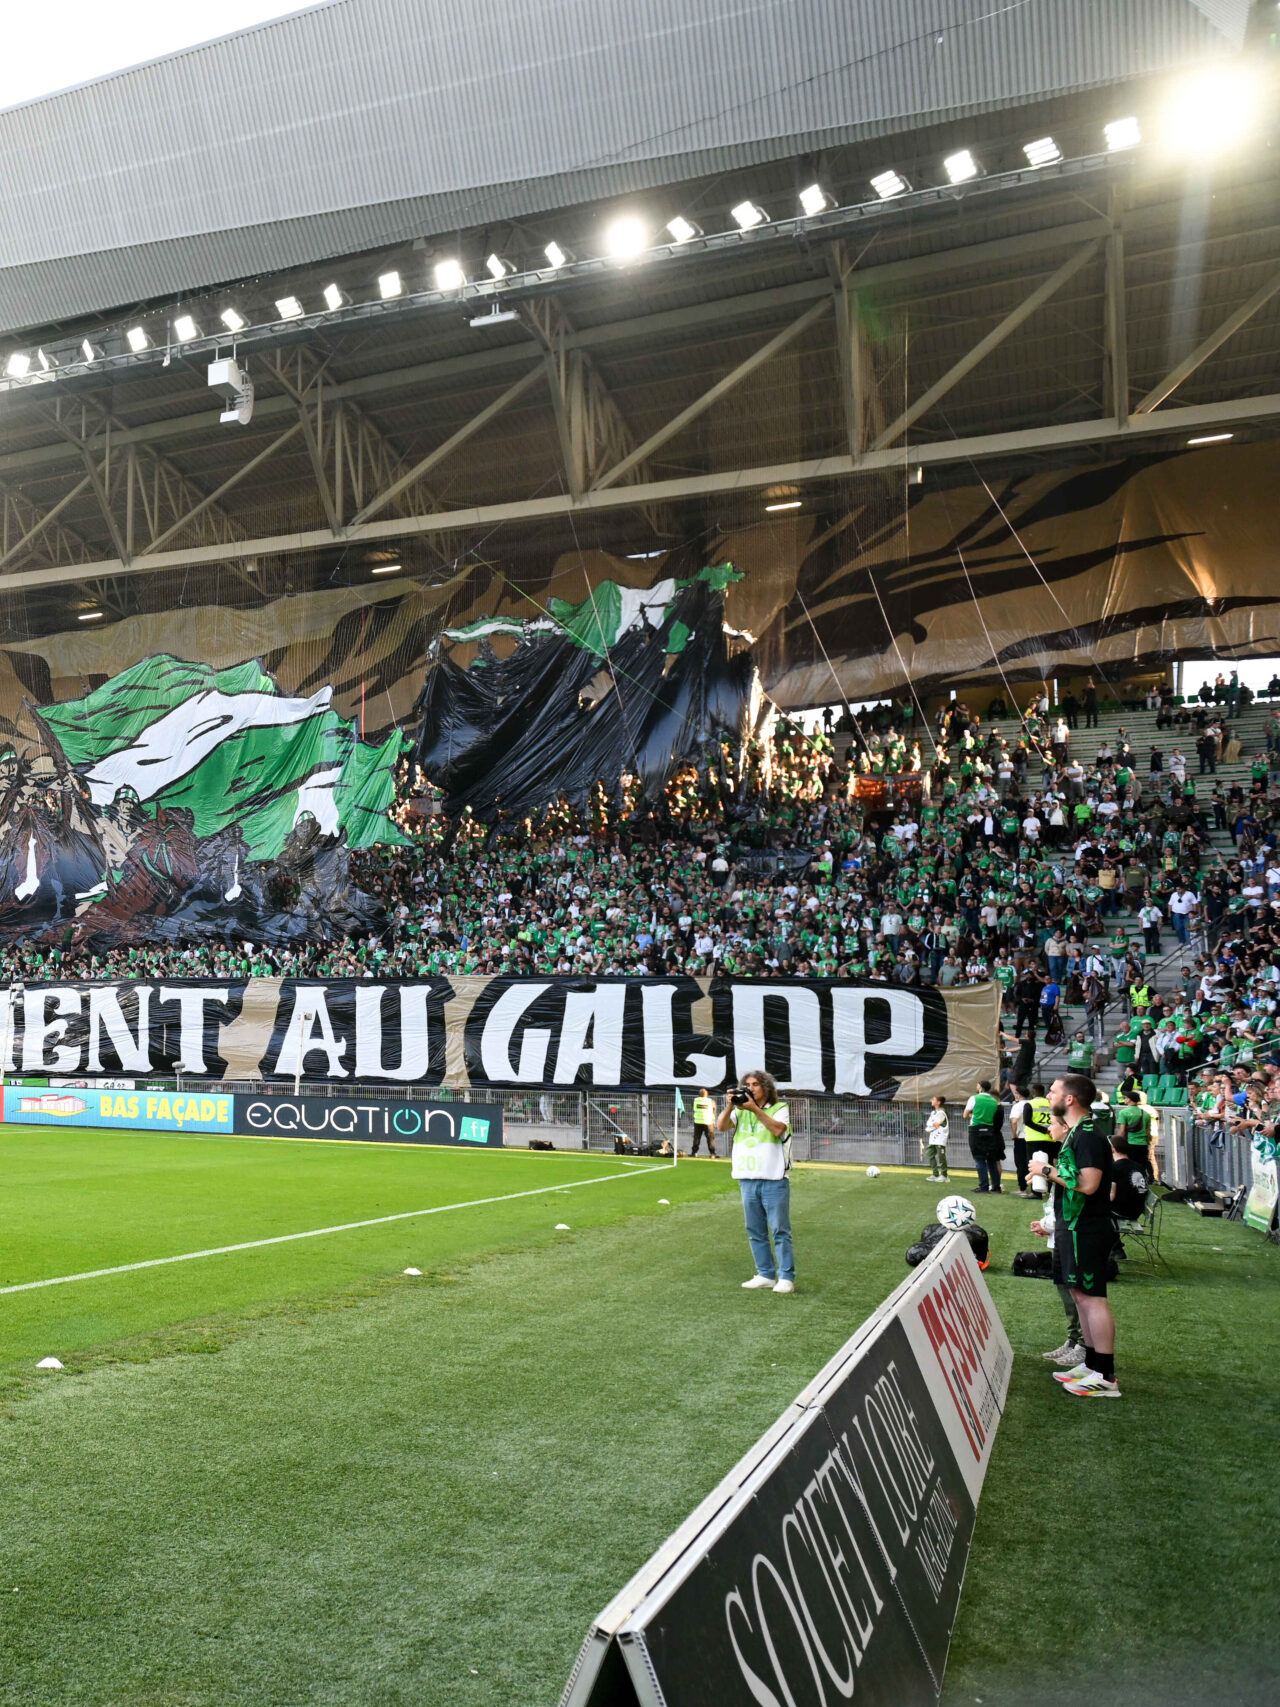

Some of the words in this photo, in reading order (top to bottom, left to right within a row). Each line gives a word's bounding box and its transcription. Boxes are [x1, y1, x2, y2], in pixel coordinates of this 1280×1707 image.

[275, 985, 431, 1080] AU
[481, 983, 924, 1098] GALOP
[100, 1095, 139, 1118] BAS
[146, 1097, 229, 1127] FAÇADE
[852, 1361, 935, 1546] LOIRE
[914, 1476, 958, 1605] MAGAZINE
